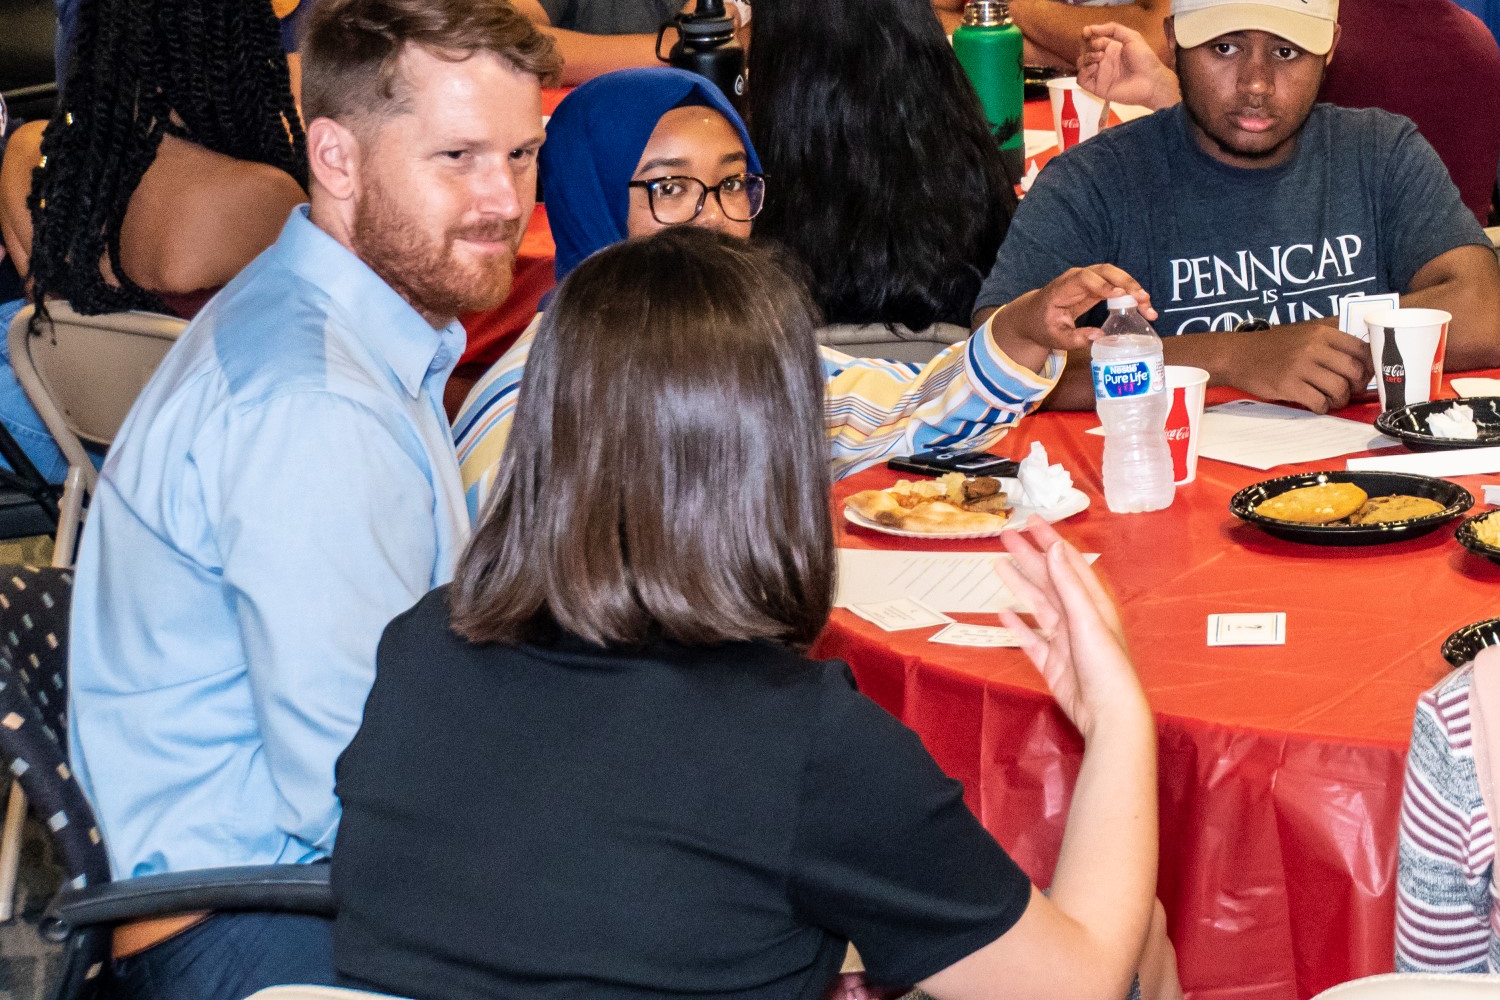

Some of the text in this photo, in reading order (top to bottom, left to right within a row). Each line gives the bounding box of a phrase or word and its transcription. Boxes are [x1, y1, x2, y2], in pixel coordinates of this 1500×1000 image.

[1170, 235, 1362, 302] PENNCAP
[1262, 289, 1279, 305] IS
[1105, 374, 1129, 385] Pure
[1129, 370, 1148, 386] Life
